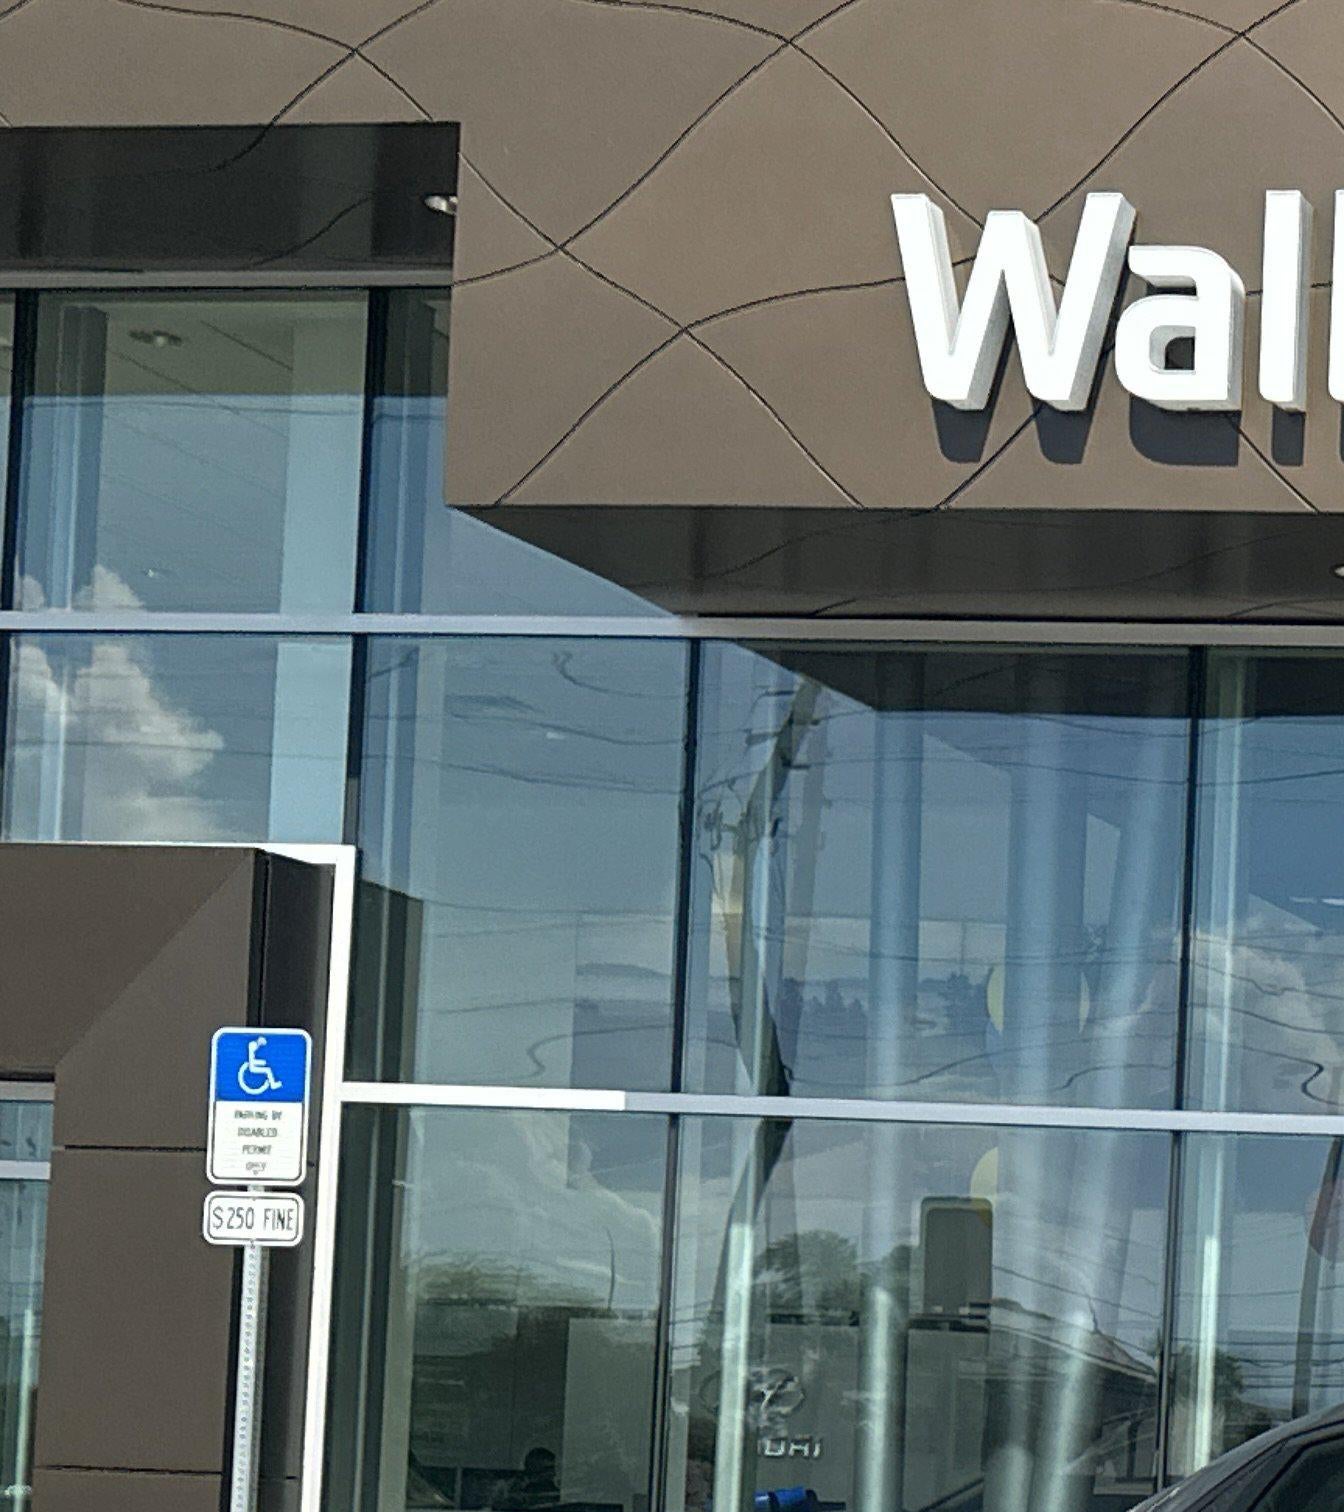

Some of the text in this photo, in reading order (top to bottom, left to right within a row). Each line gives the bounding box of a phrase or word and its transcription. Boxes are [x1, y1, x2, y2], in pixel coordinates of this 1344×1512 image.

[271, 1110, 283, 1120] BY
[212, 1205, 296, 1231] $250 FINE
